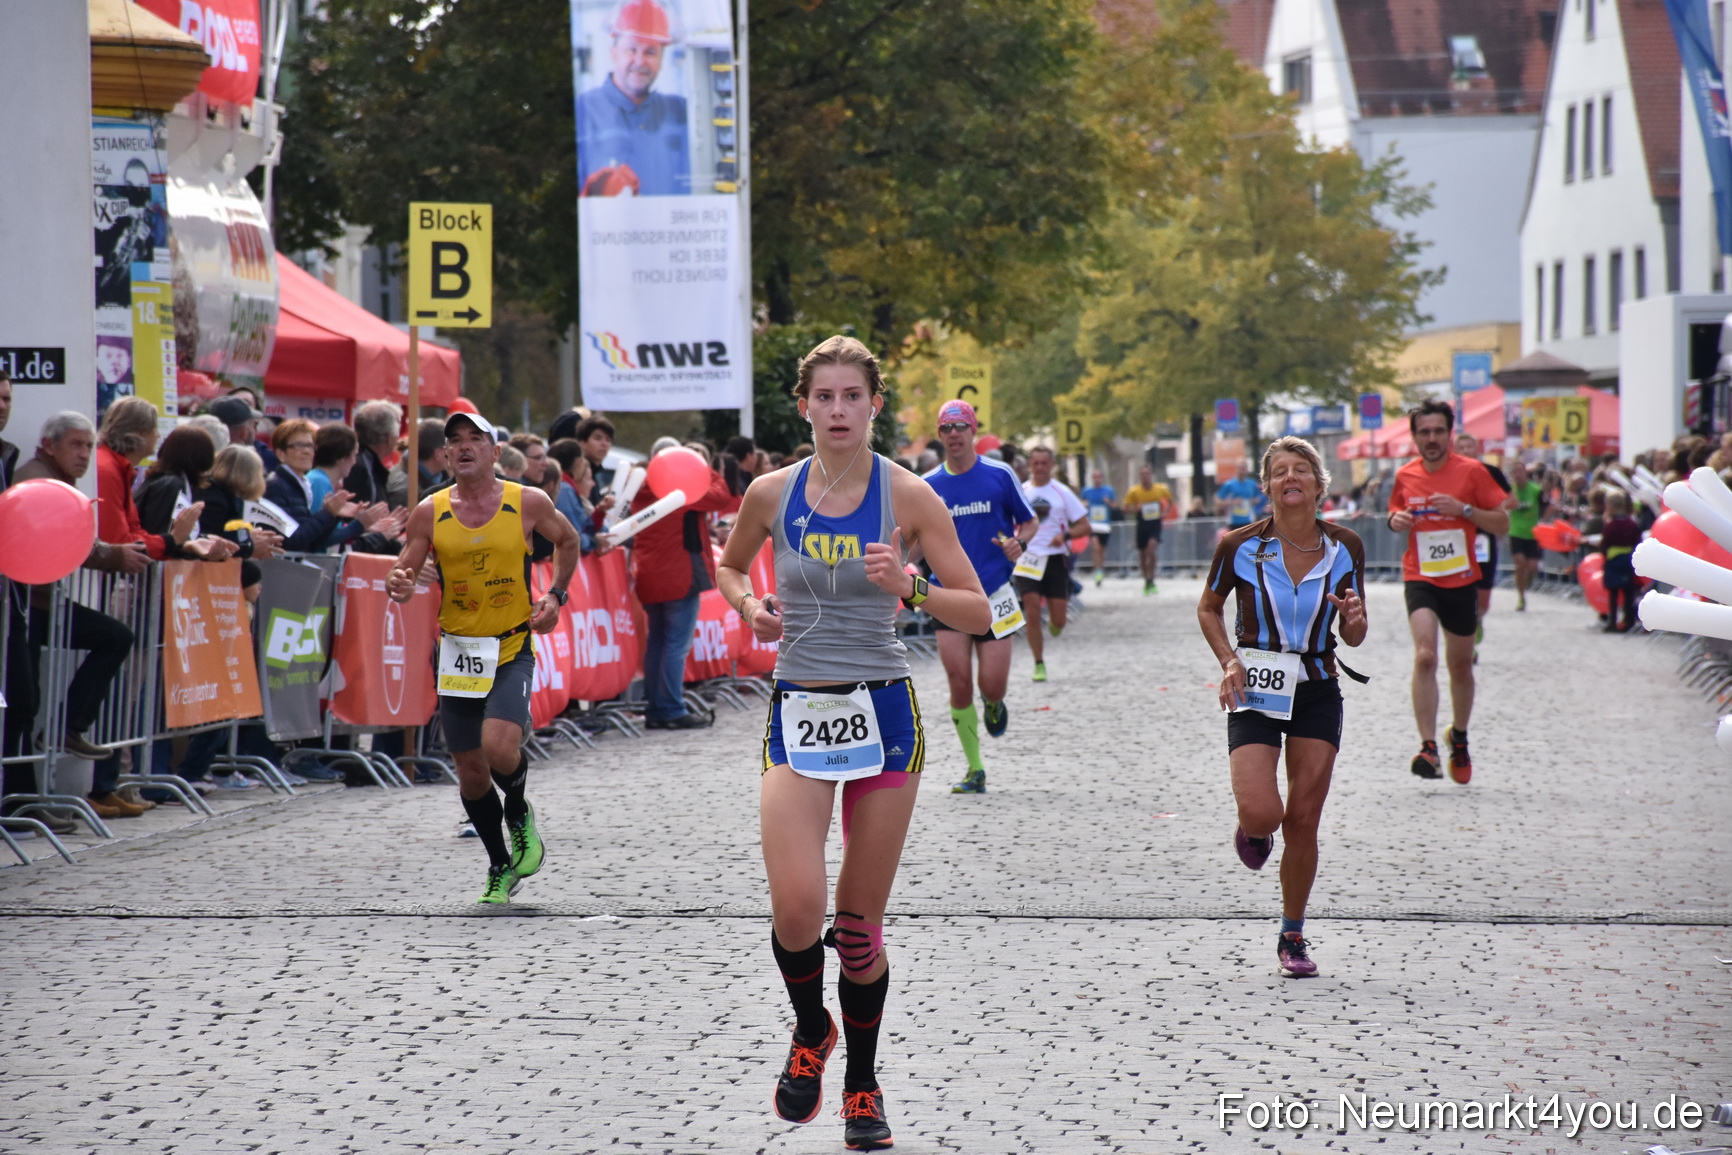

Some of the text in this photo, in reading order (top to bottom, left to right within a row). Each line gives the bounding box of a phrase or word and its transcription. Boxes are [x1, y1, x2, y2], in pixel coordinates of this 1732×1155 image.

[419, 208, 482, 231] Block
[431, 241, 471, 299] B
[136, 301, 159, 324] 18.
[0, 351, 54, 379] tl.de
[951, 367, 984, 379] Block
[1066, 420, 1083, 444] D
[1566, 411, 1584, 435] D
[1429, 543, 1455, 559] 294
[454, 653, 484, 674] 415
[1252, 651, 1277, 659] BOCK
[444, 677, 479, 691] Robert
[797, 713, 869, 747] 2428
[824, 755, 849, 766] Julia
